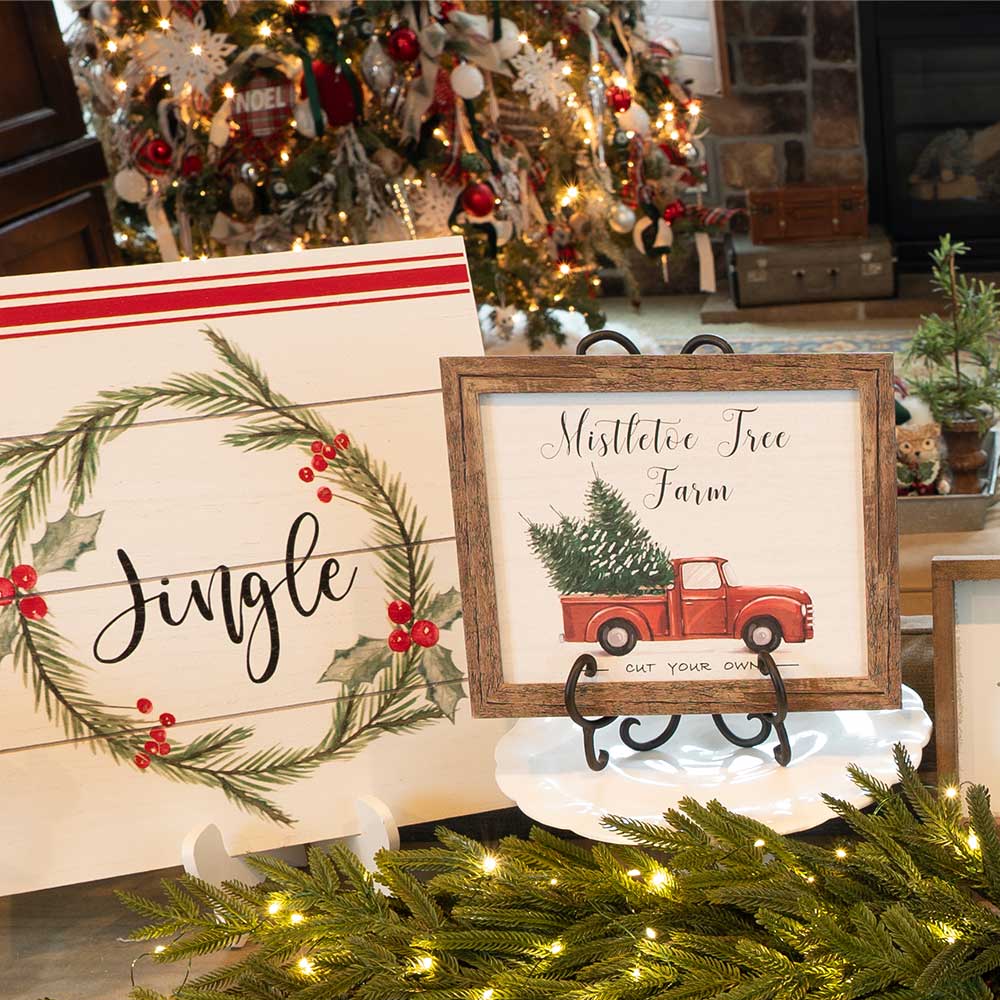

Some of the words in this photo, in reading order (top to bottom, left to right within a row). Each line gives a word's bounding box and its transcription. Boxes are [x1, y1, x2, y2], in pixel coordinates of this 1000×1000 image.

[235, 86, 286, 114] NOEL
[540, 407, 698, 460] Mistletoe
[717, 406, 791, 458] Tree
[643, 465, 735, 510] Farm
[93, 511, 358, 684] Jingle
[625, 663, 657, 673] CUT
[667, 662, 712, 676] YOUR
